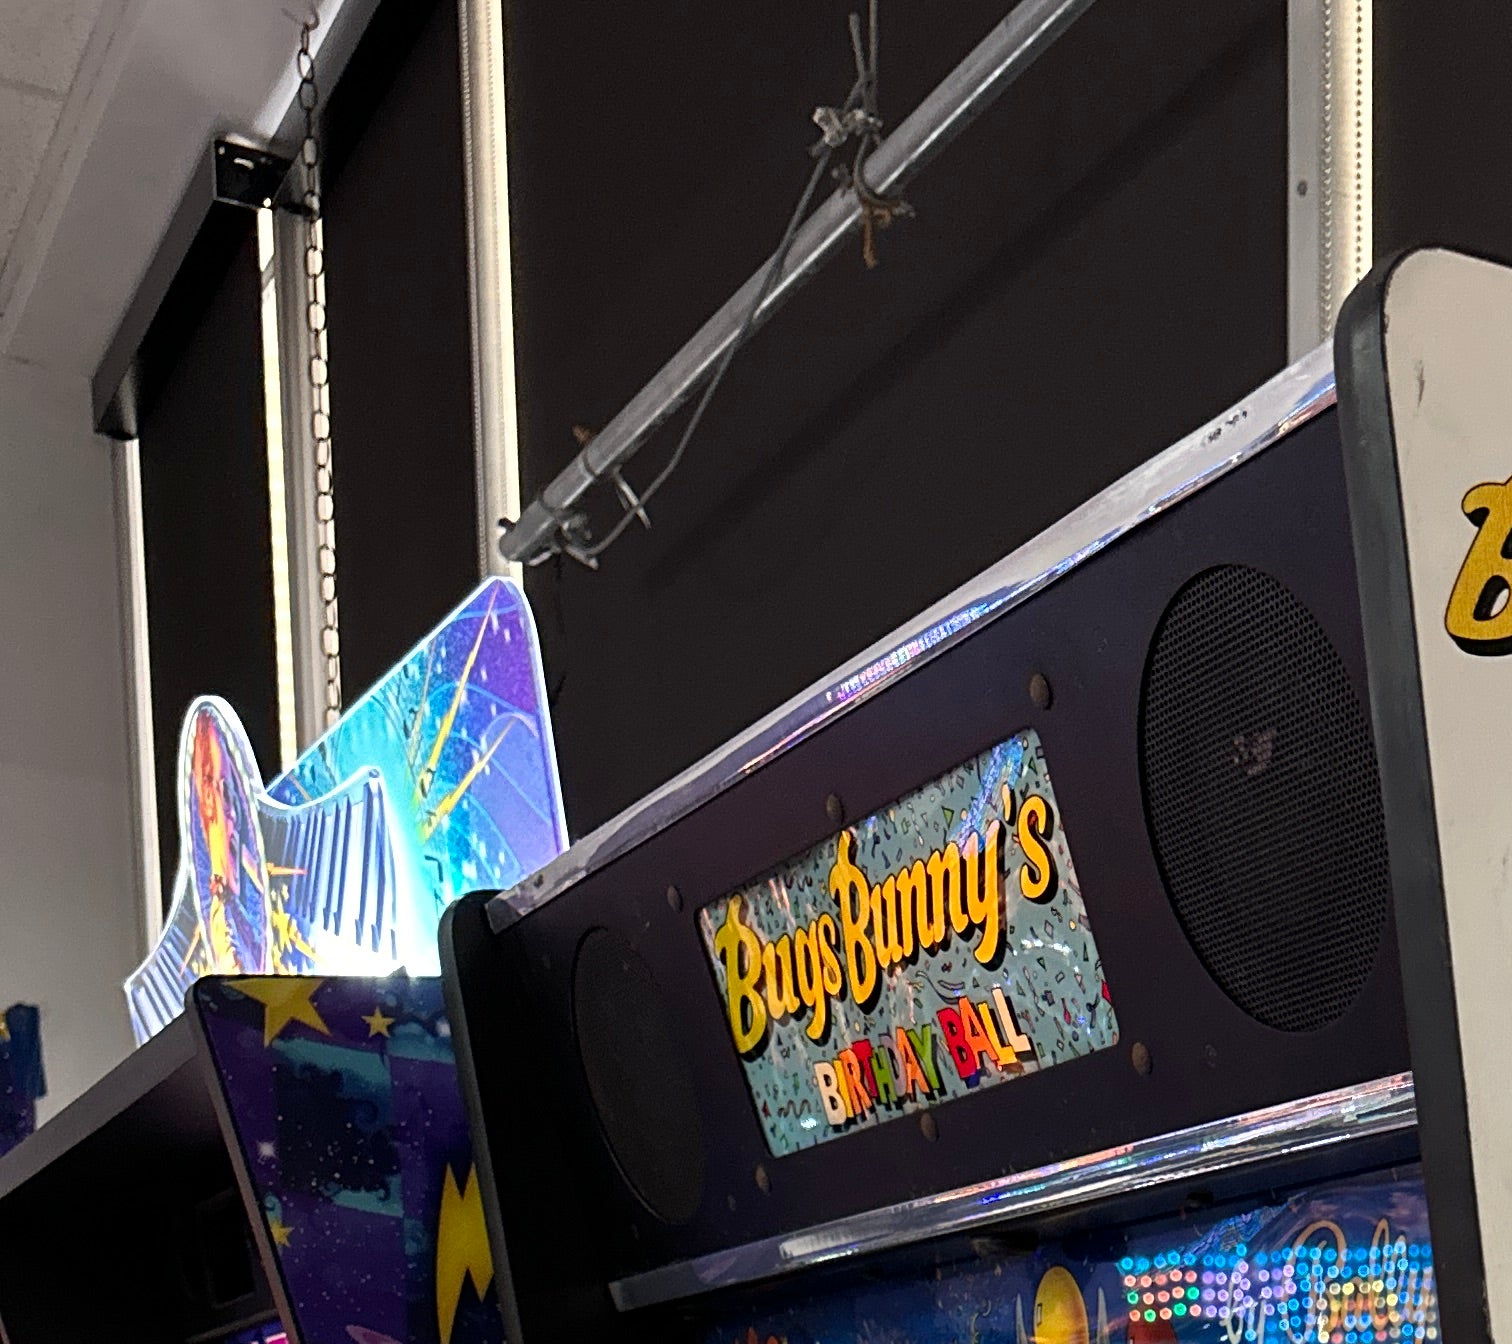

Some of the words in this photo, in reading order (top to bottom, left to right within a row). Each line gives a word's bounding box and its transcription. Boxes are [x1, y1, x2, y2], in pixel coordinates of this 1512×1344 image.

[714, 893, 845, 1062] Bugs
[829, 782, 1059, 1015] Bunny's
[813, 1020, 946, 1132] BIRTHDAY
[936, 986, 1041, 1088] BALL
